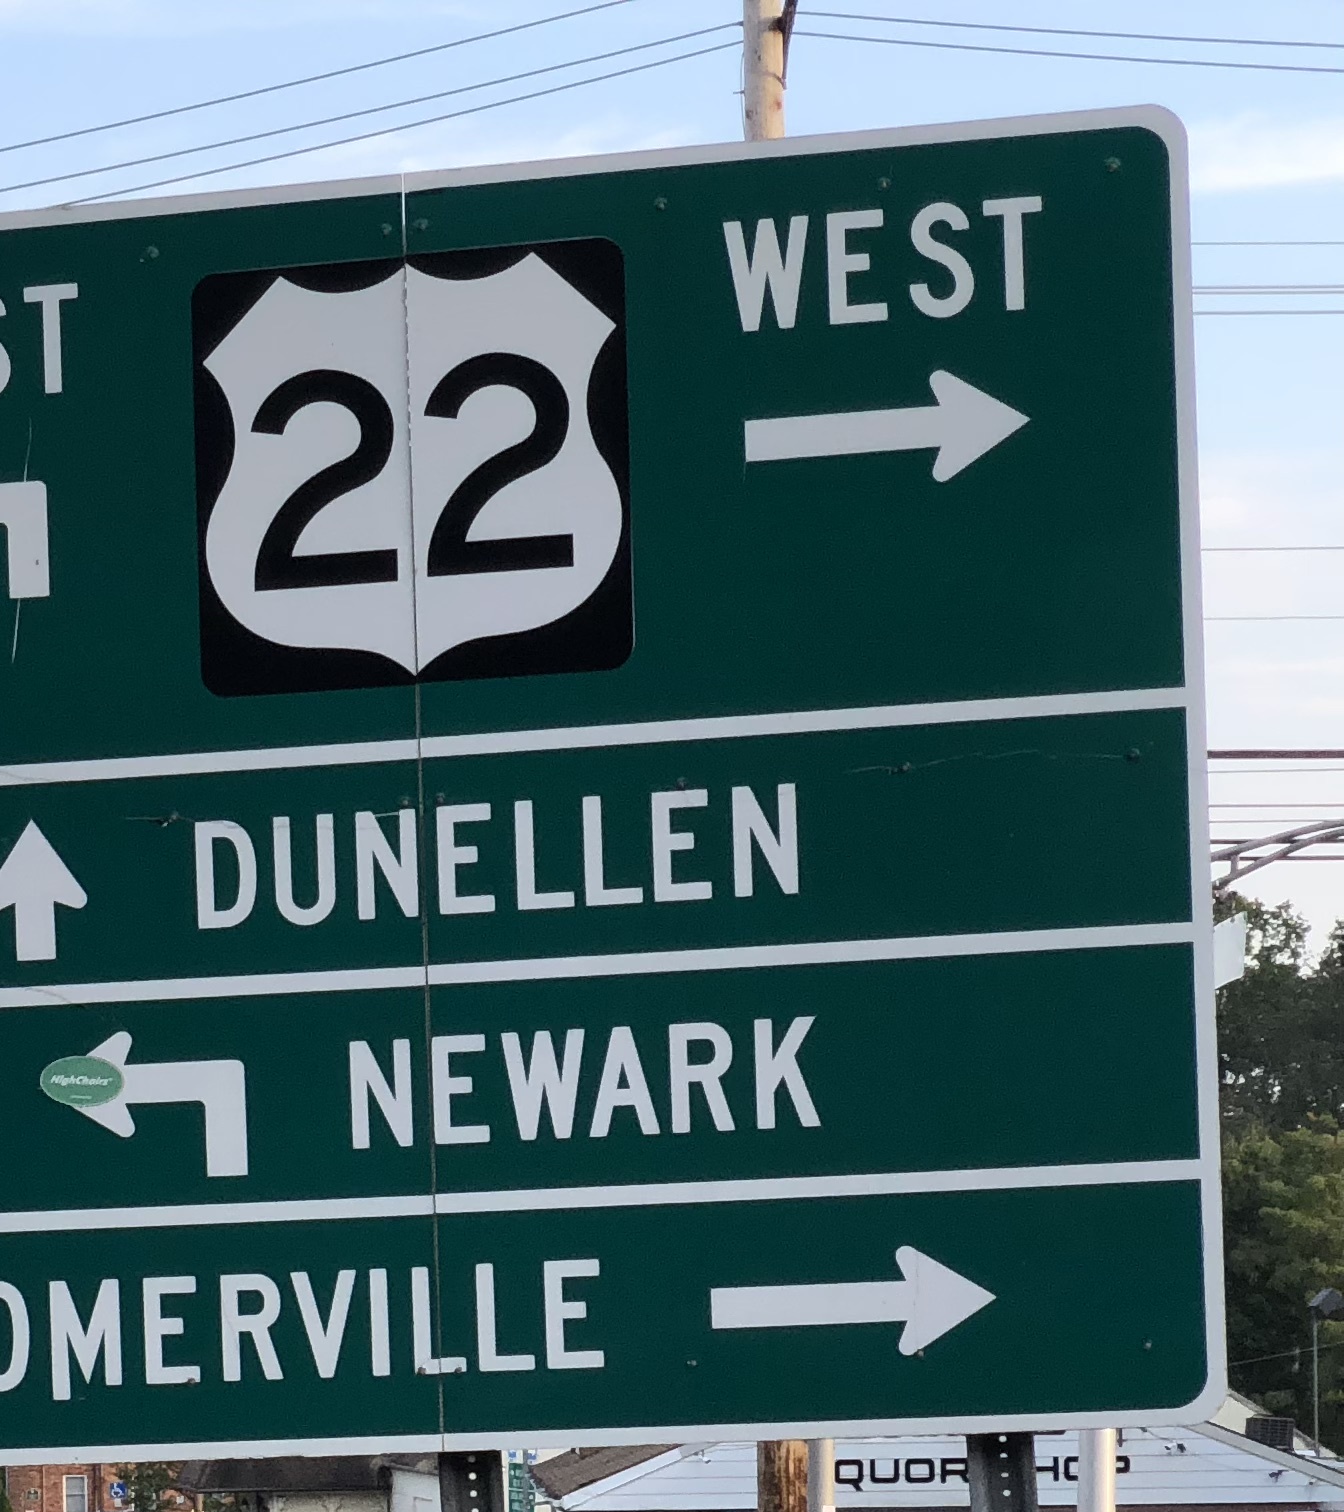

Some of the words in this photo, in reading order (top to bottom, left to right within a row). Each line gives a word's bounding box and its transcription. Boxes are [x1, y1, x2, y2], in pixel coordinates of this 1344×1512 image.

[723, 196, 1042, 332] WEST
[250, 352, 575, 593] 22
[194, 783, 800, 929] DUNELLEN
[348, 1016, 822, 1149] NEWARK
[834, 1457, 970, 1492] QUOR
[1035, 1455, 1131, 1482] HOP
